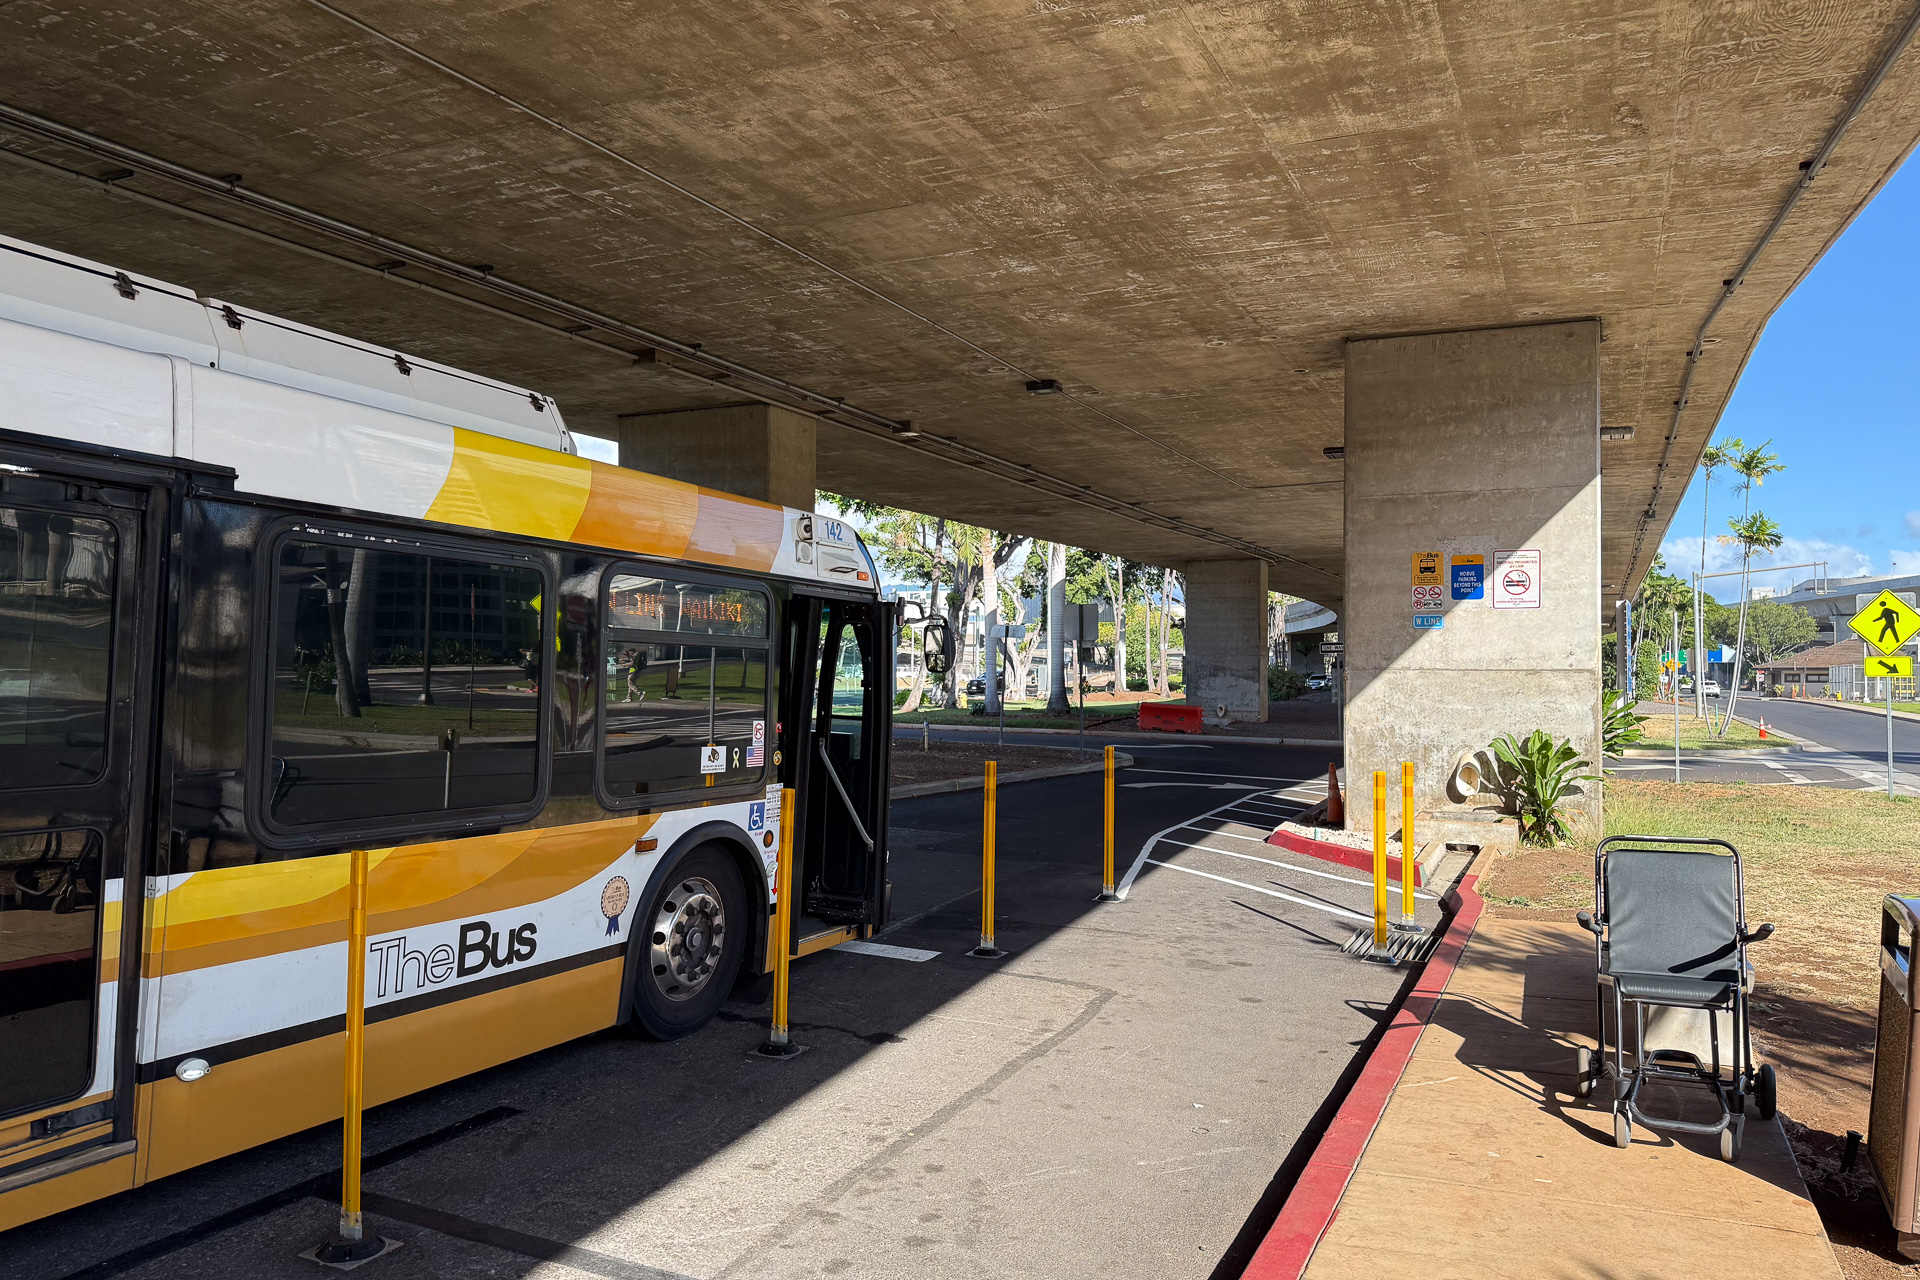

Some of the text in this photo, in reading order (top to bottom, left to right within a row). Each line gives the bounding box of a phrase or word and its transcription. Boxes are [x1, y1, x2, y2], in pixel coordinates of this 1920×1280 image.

[825, 520, 843, 541] 142
[680, 597, 743, 623] WAIKIKI
[1415, 617, 1441, 625] W LINE
[369, 920, 538, 998] TheBus
